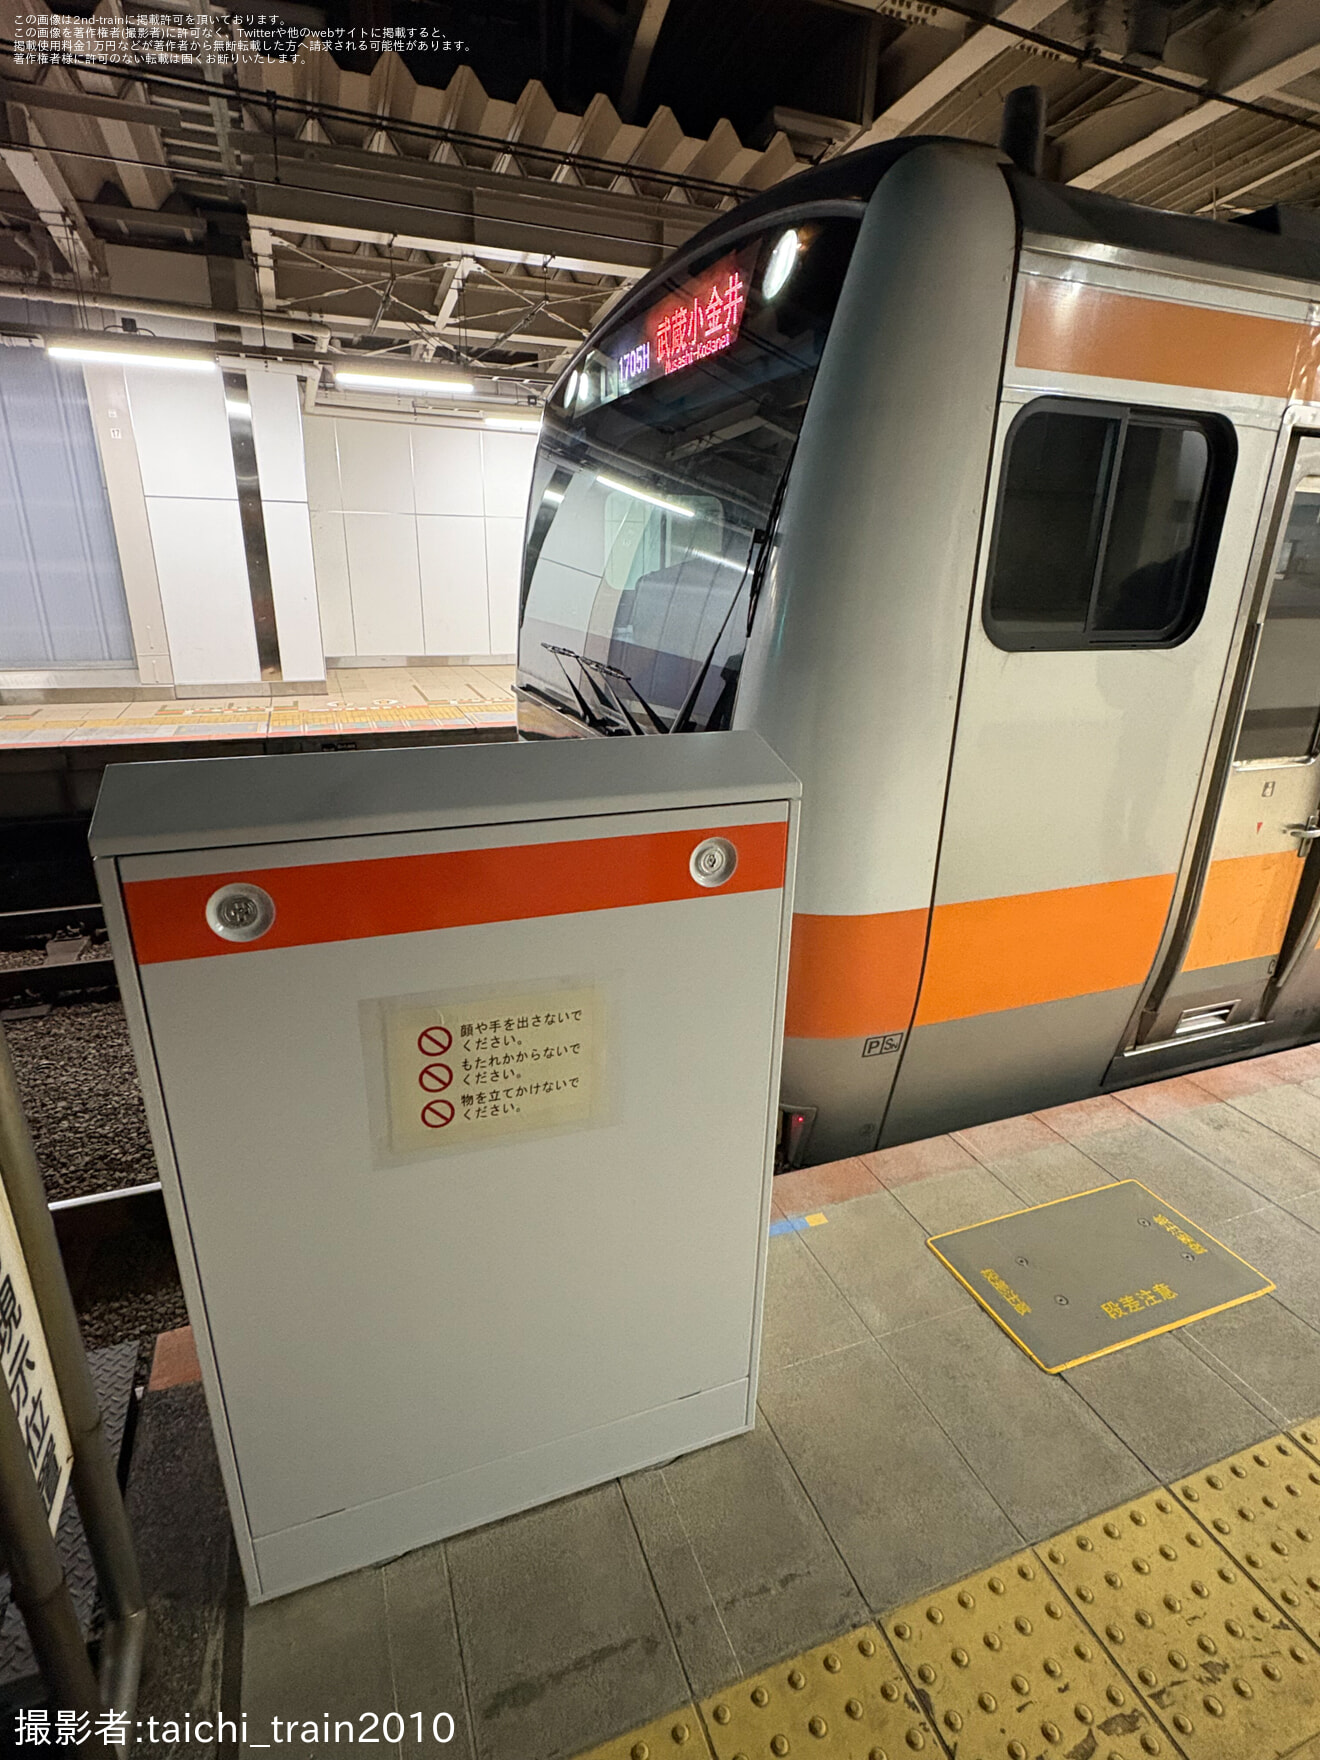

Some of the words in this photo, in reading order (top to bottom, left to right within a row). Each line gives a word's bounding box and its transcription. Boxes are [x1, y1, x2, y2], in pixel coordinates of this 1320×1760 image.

[656, 272, 743, 363] 武蔵小金井
[619, 342, 650, 382] 1705H
[460, 1010, 582, 1038] 顔や手を出さないで
[461, 1043, 581, 1071] もたれかからないで
[463, 1035, 522, 1052] ください。
[463, 1069, 521, 1086] ください。
[461, 1077, 579, 1107] 物を立てかけないで
[463, 1103, 520, 1120] ください。
[1101, 1283, 1178, 1319] 段差注意
